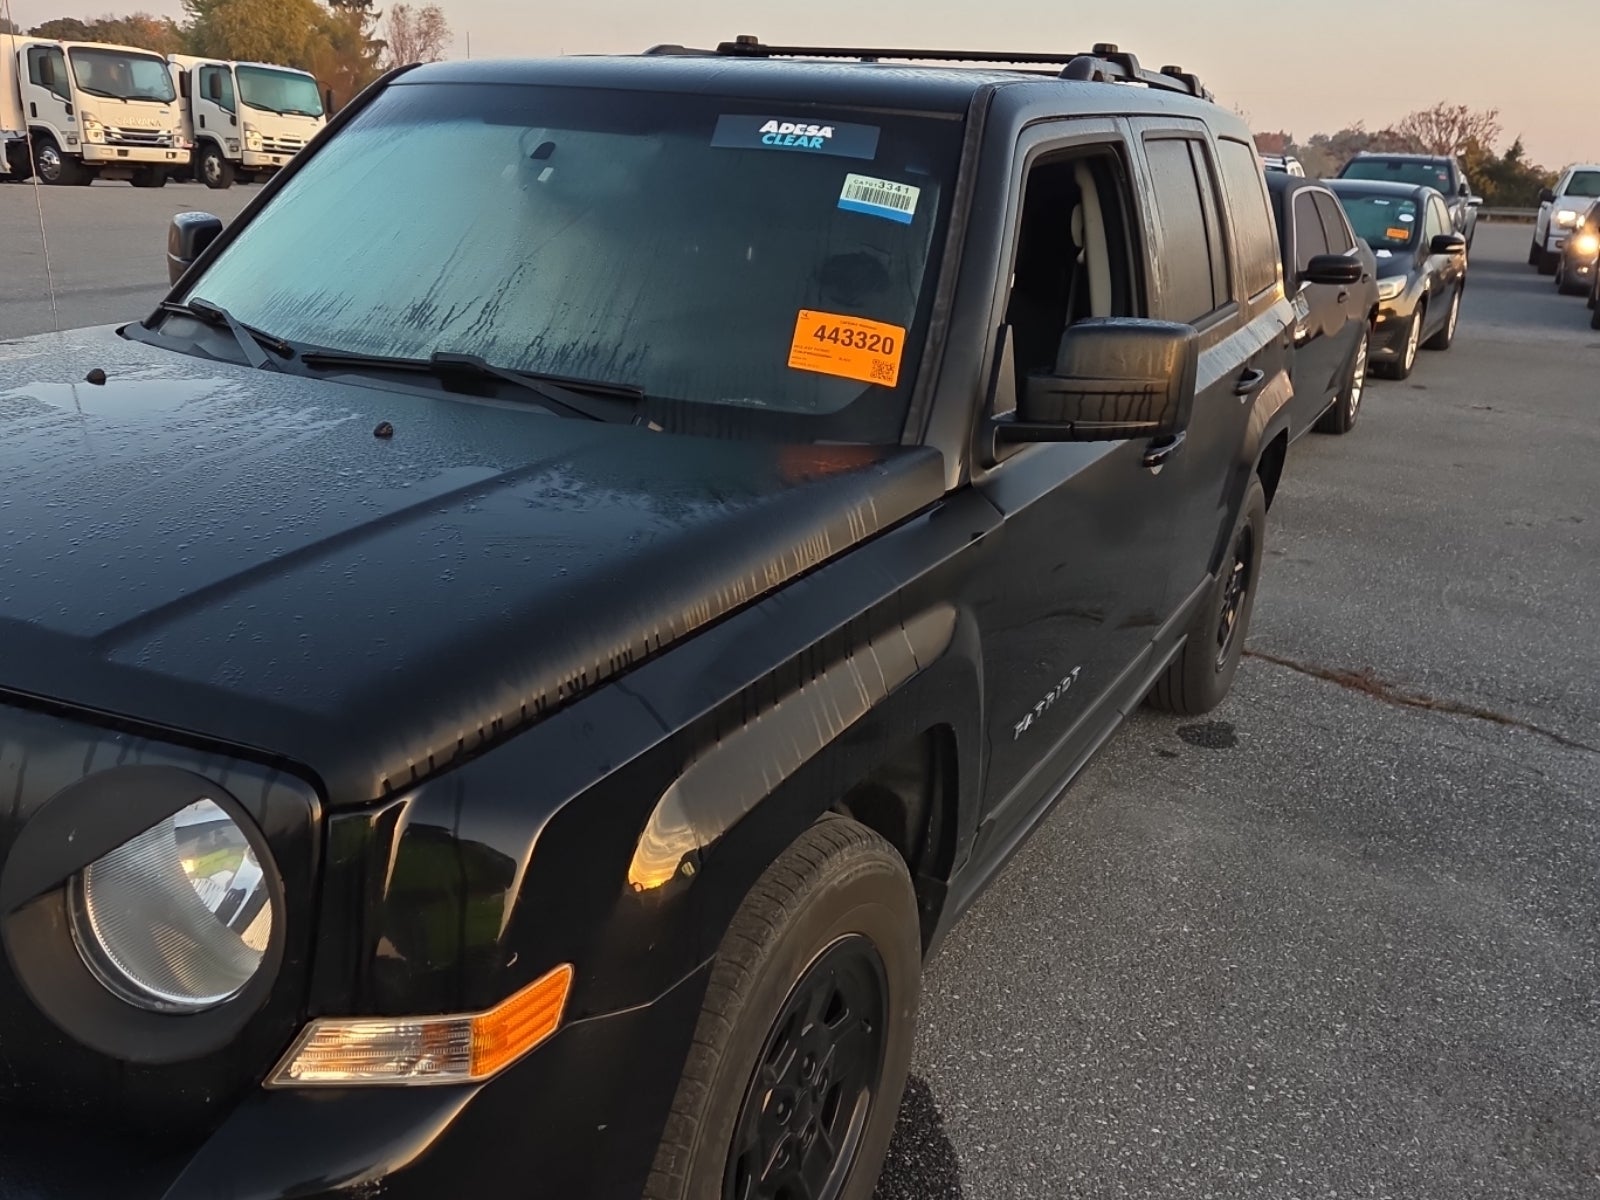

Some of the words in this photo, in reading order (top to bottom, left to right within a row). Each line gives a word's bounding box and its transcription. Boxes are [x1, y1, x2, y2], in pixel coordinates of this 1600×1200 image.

[758, 119, 834, 139] ADESA
[761, 132, 825, 149] CLEAR
[813, 324, 895, 356] 443320
[1013, 665, 1083, 741] PATRIOT
